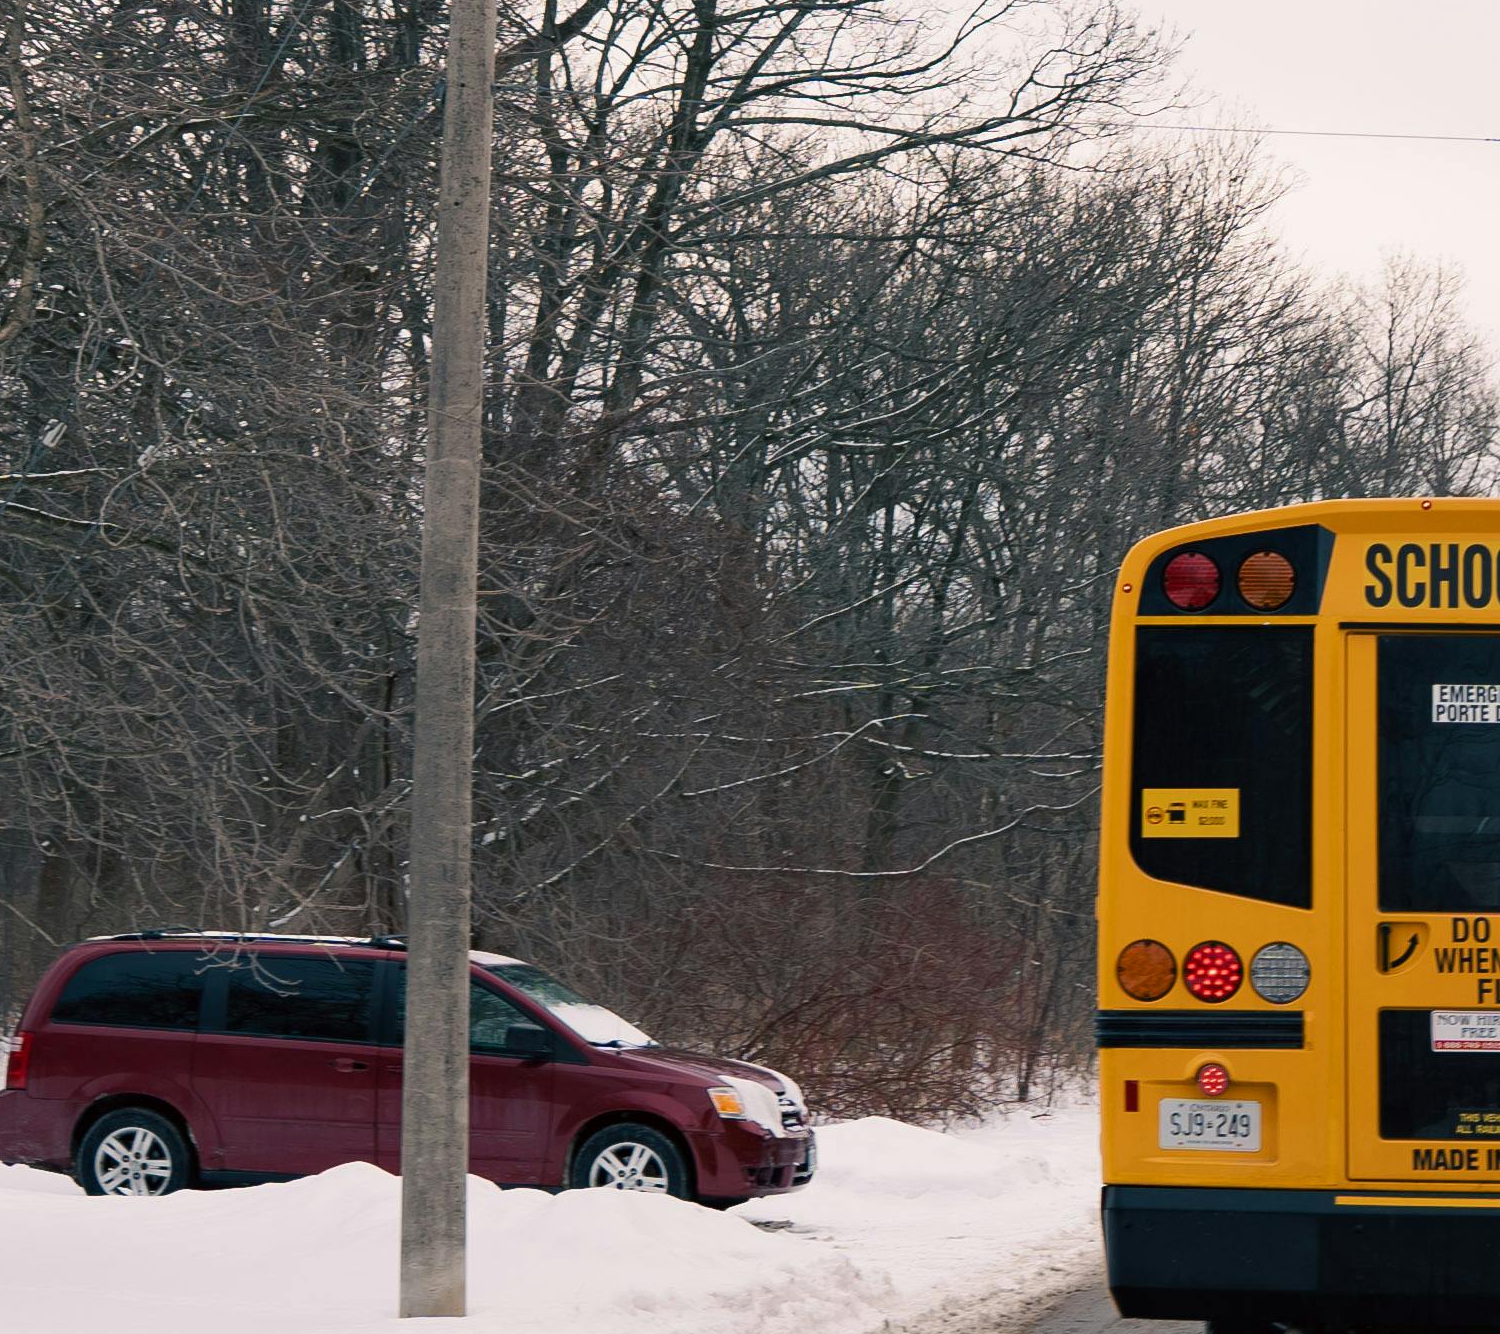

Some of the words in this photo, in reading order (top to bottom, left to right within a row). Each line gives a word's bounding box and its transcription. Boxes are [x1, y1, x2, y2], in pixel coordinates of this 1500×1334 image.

[1436, 704, 1489, 721] PORTE
[1452, 917, 1491, 943] DO
[1436, 1014, 1470, 1026] NOW
[1460, 1027, 1498, 1038] FREE
[1459, 1113, 1481, 1122] THIS
[1455, 1125, 1473, 1134] ALL
[1412, 1148, 1479, 1170] MADE
